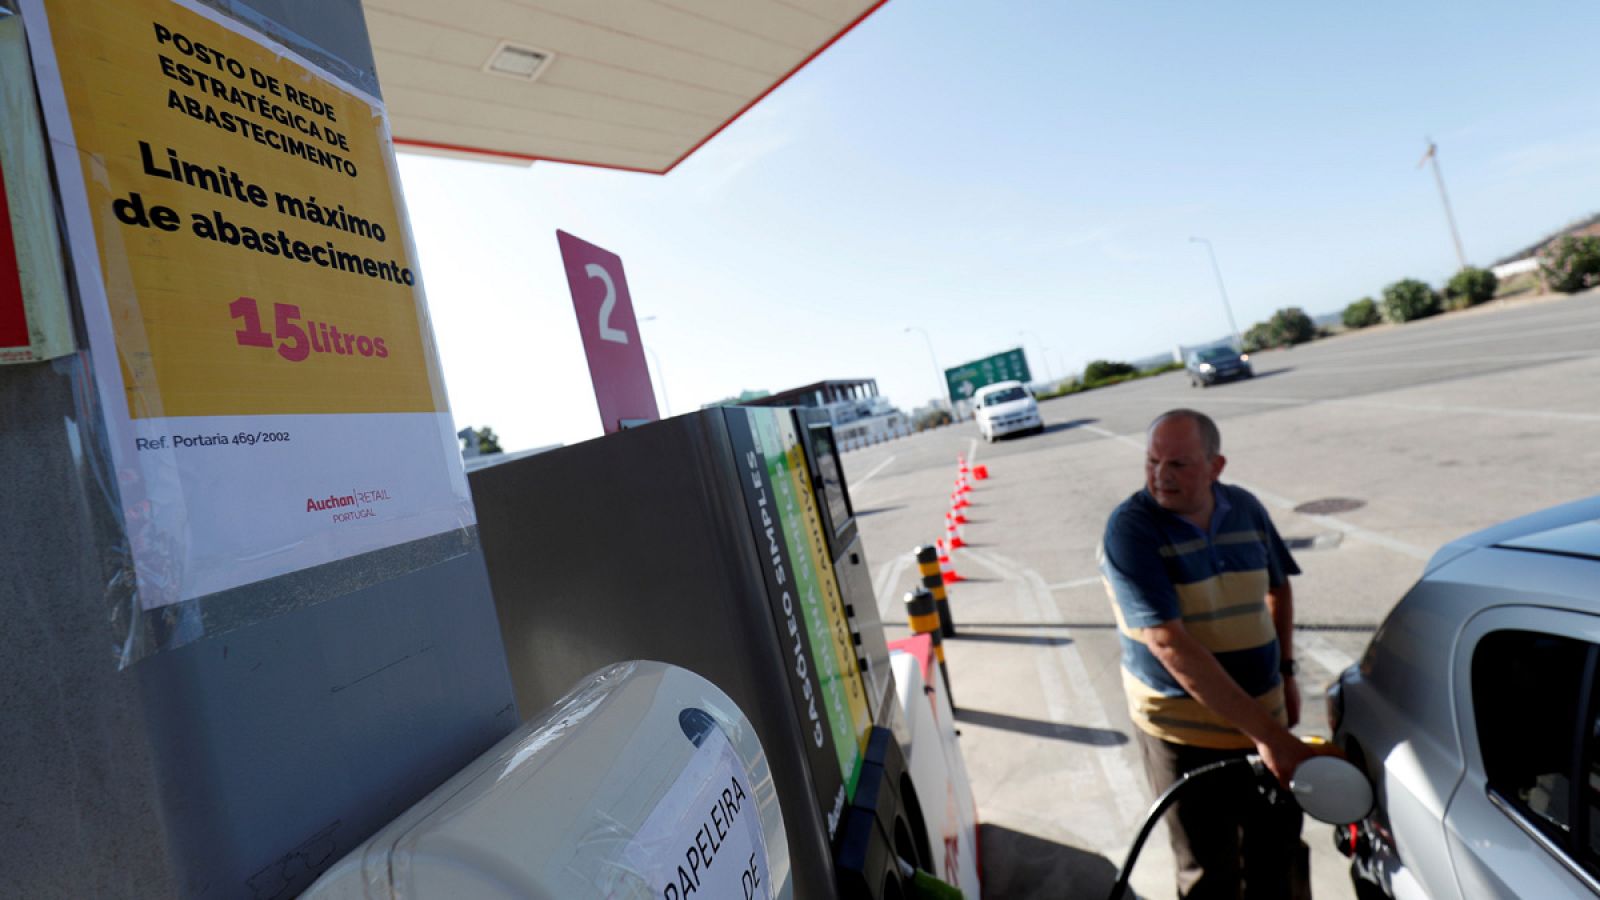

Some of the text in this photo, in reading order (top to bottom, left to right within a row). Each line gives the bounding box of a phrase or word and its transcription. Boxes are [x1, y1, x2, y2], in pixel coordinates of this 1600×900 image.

[153, 22, 337, 122] POSTO DE REDE
[159, 54, 351, 152] ESTRATÉGICA DE
[167, 89, 357, 178] ABASTECIMENTO
[138, 140, 386, 243] Limite máximo
[112, 192, 415, 287] de abastecimento
[585, 263, 628, 344] 2
[135, 431, 290, 451] Ref. Portaria 469/2002
[306, 488, 391, 513] Auchan RETAIL
[333, 509, 376, 523] PORTUGAL
[746, 450, 786, 585] SIMPLES
[742, 852, 761, 900] DE
